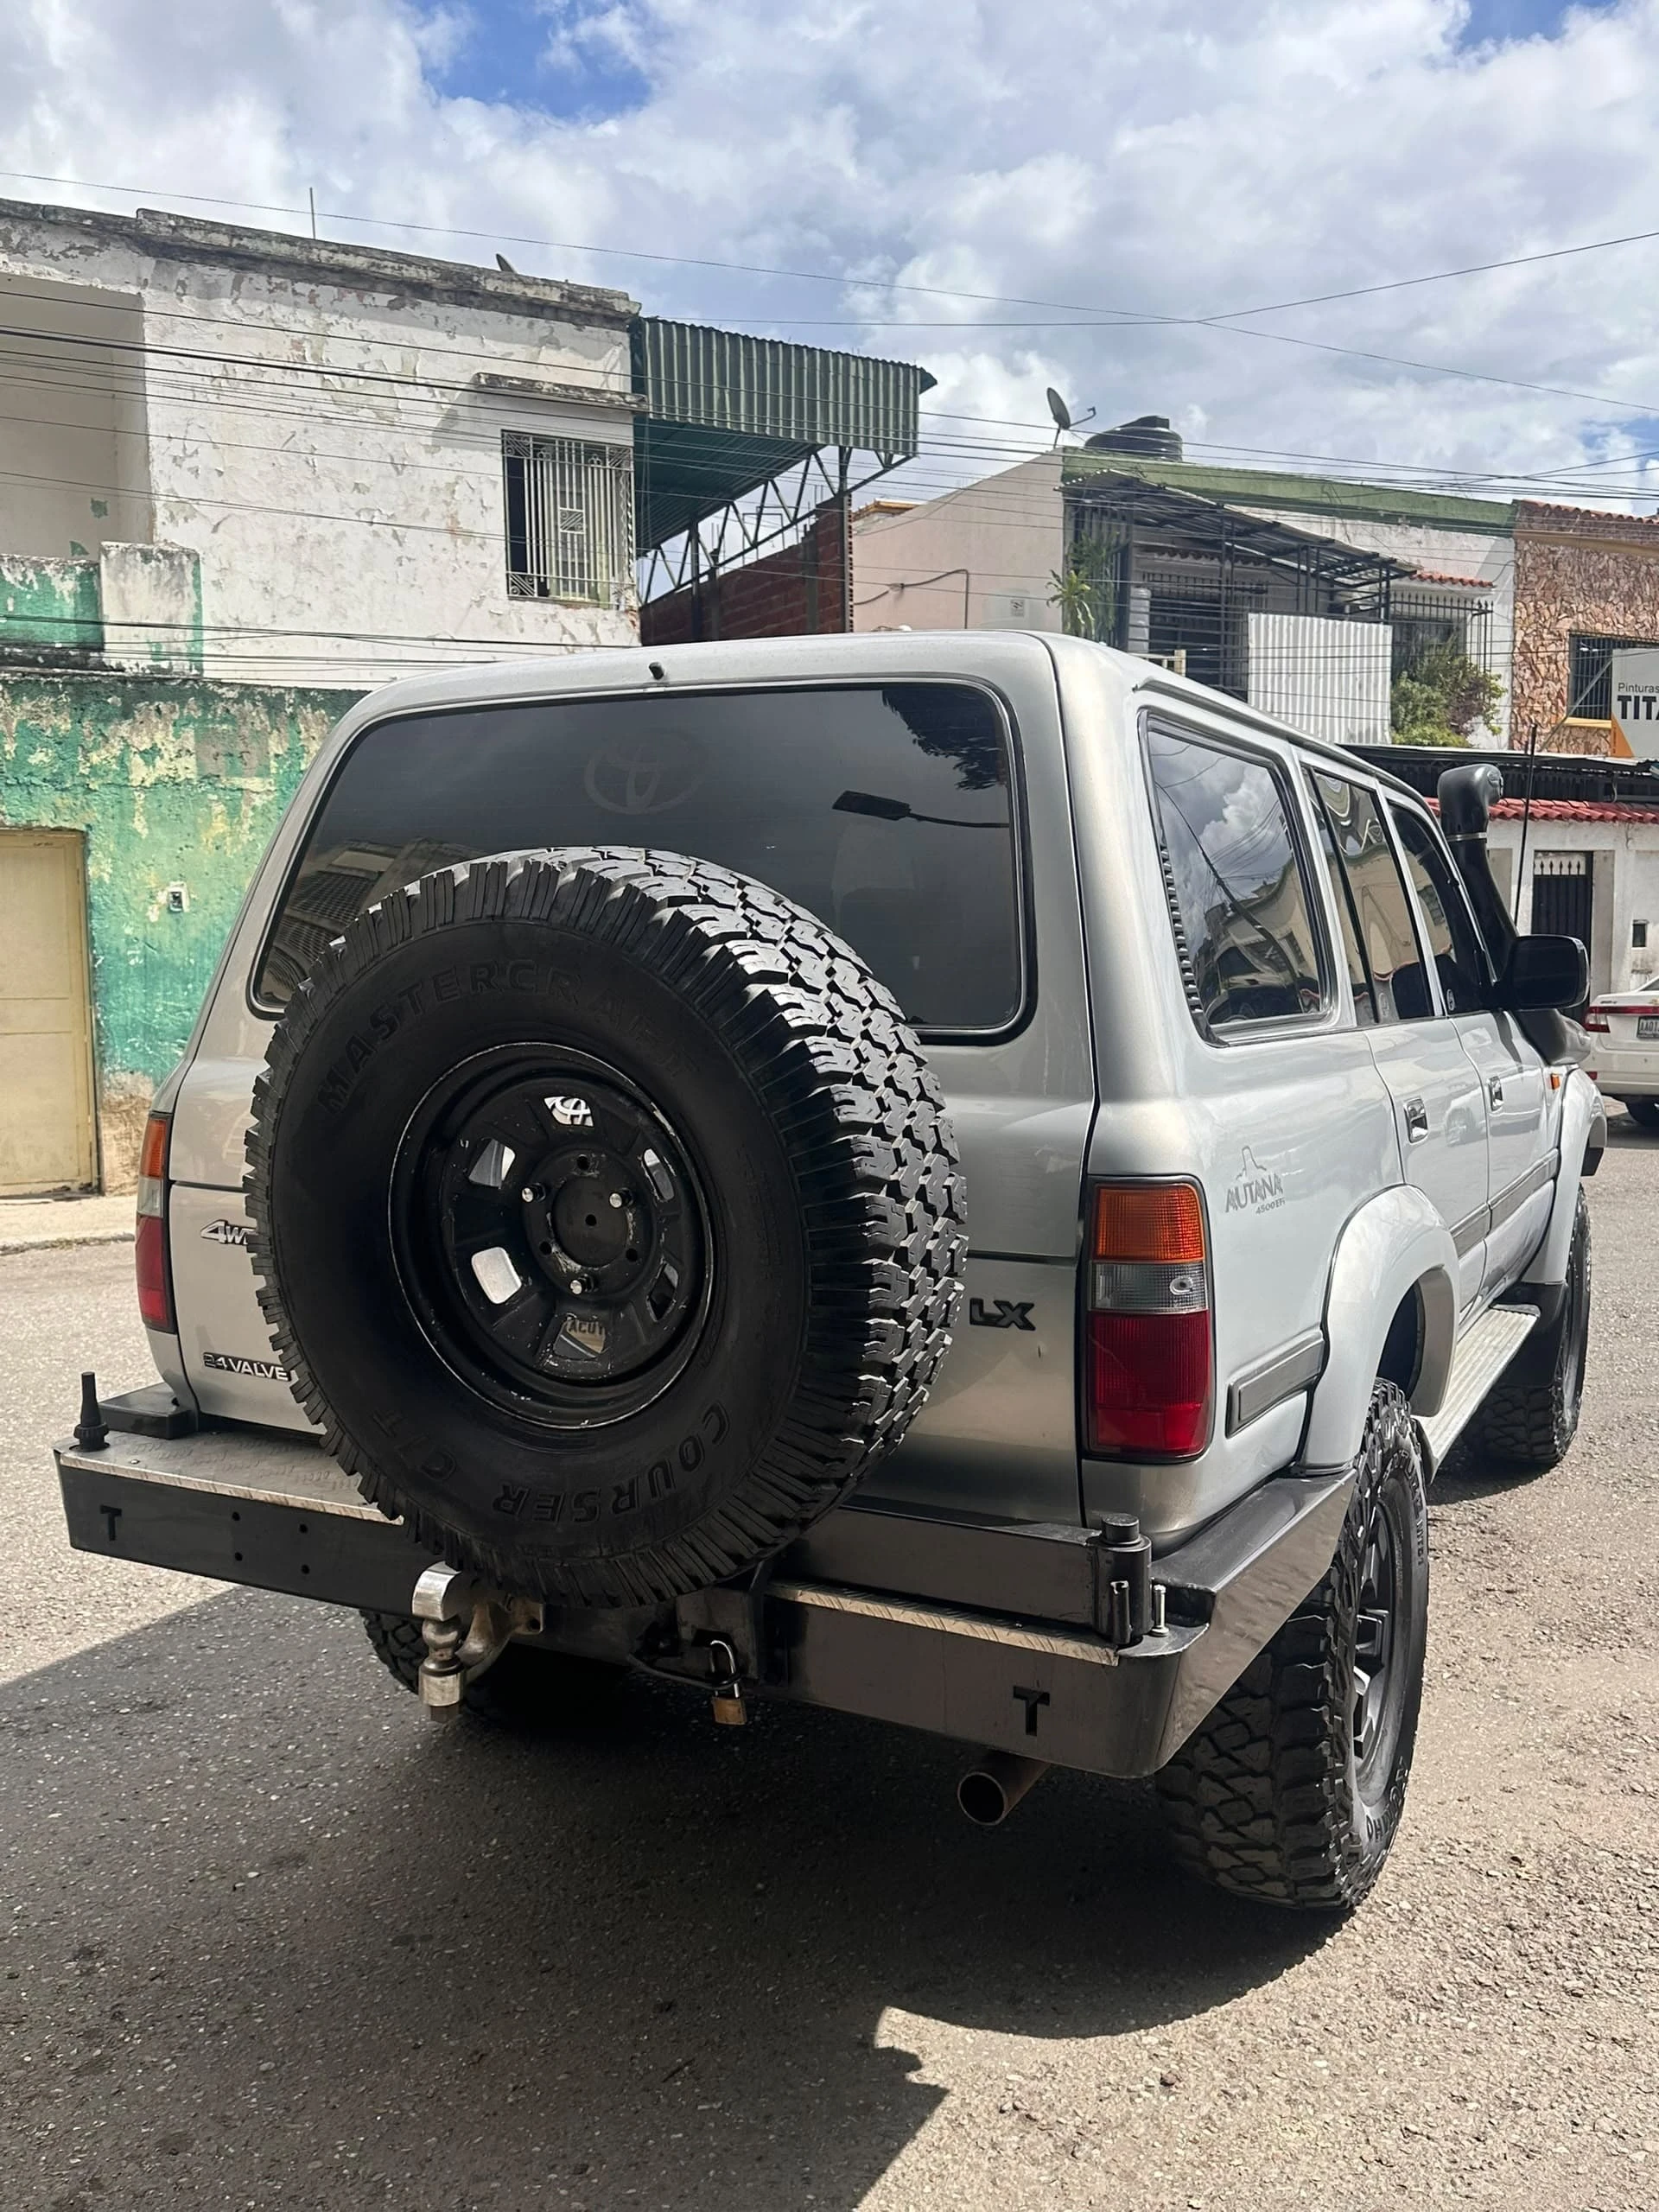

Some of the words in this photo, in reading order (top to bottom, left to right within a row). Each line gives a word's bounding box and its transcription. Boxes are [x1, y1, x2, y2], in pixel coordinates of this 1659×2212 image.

[1618, 682, 1659, 694] Pinturas
[1225, 1173, 1283, 1213] AUTANA
[969, 1298, 1036, 1331] LX
[492, 1401, 731, 1522] COURSER
[100, 1504, 123, 1541] T
[1013, 1685, 1051, 1736] T
